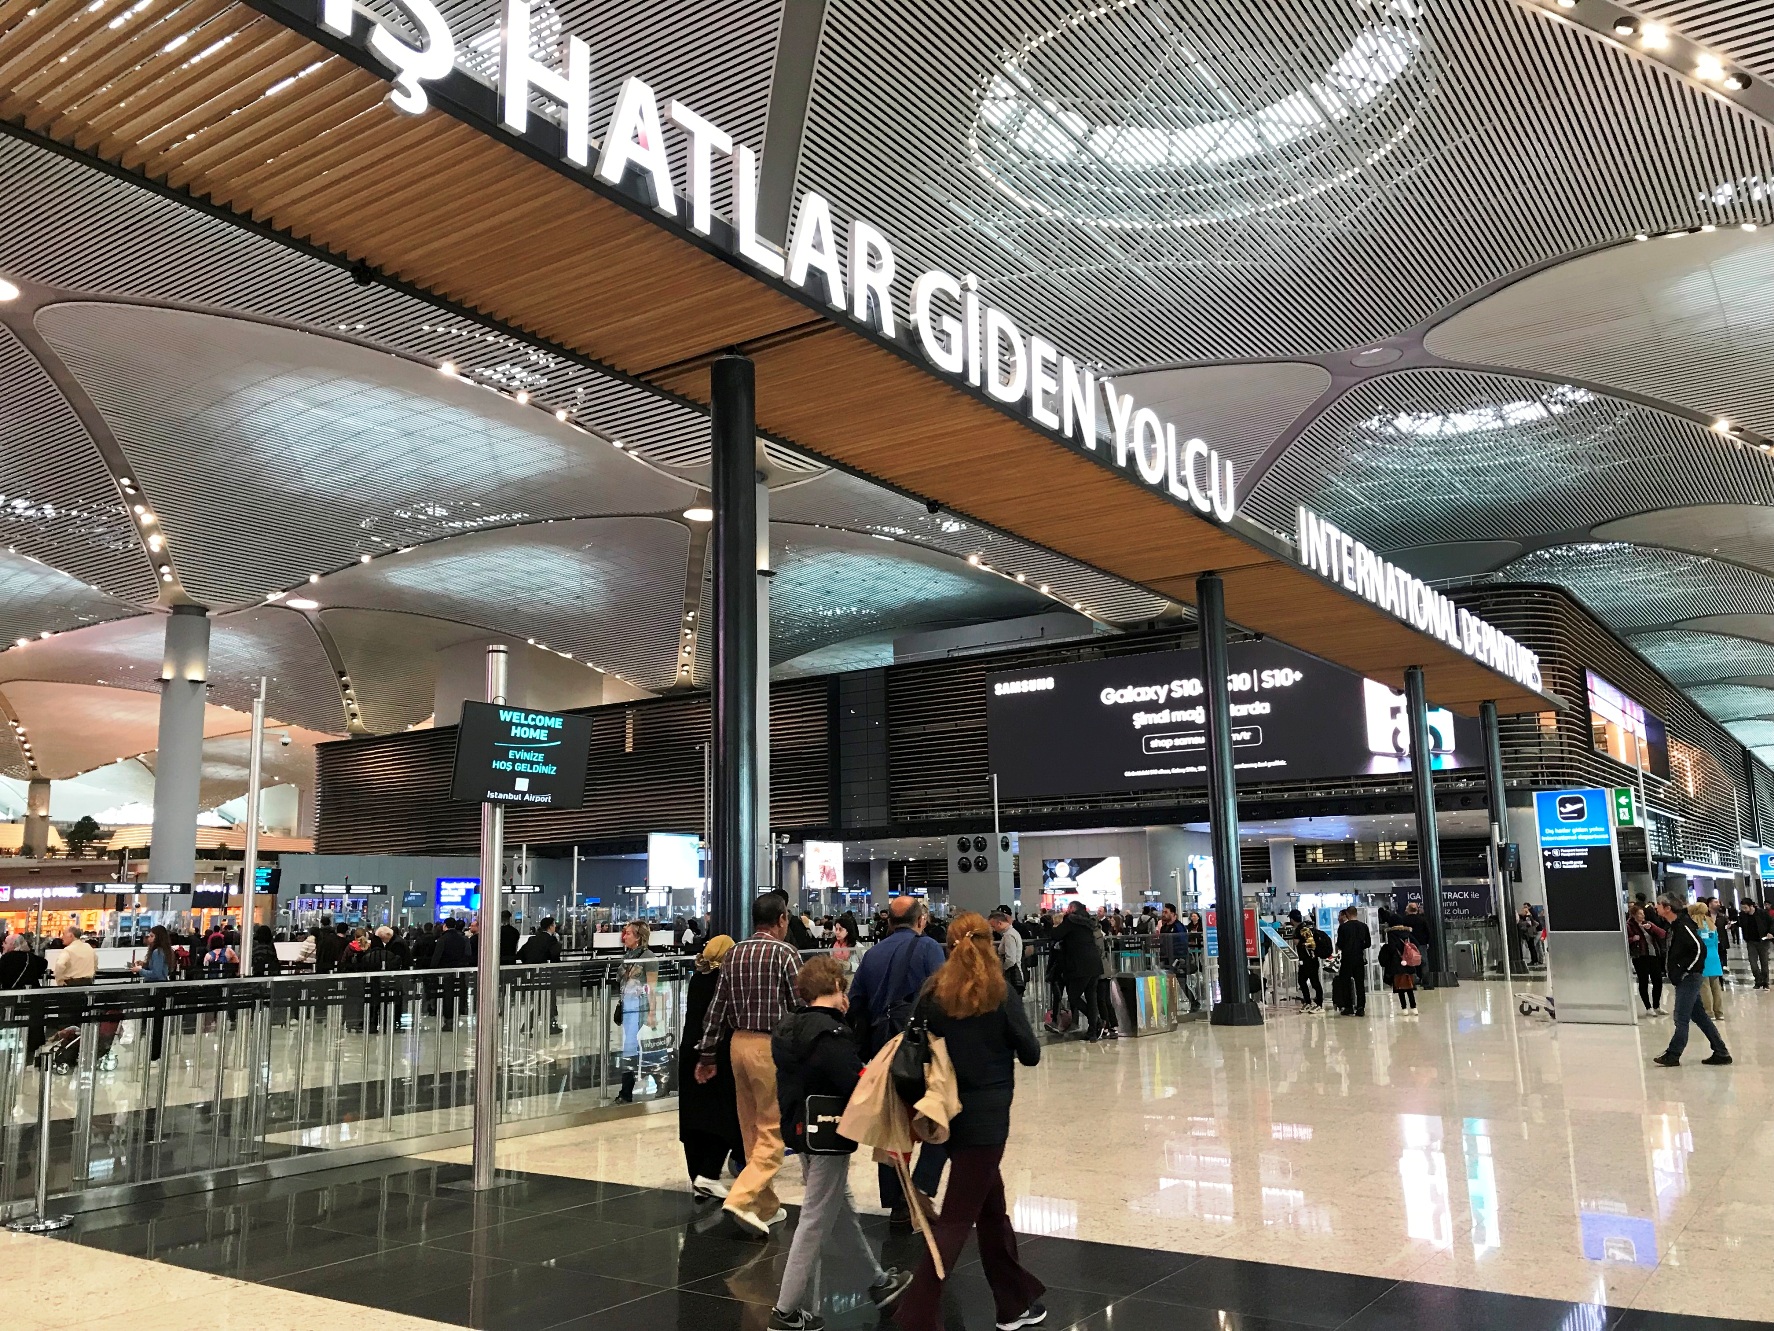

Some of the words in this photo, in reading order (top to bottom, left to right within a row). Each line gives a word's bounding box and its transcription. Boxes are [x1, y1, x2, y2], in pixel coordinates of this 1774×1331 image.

[501, 0, 896, 338] HATLAR
[910, 270, 1096, 451] GİDEN
[1100, 381, 1235, 523] YOLCU
[1299, 505, 1462, 650] INTERNATIONAL
[1458, 607, 1543, 693] DEPARTURES
[994, 677, 1055, 696] SAMSUNG
[1100, 684, 1169, 705] Galaxy
[1170, 678, 1204, 698] S10
[1261, 668, 1304, 689] S10+
[499, 709, 564, 729] WELCOME
[1132, 709, 1171, 729] Şimdi
[510, 725, 549, 741] HOME
[508, 749, 545, 762] EVİNİZE
[492, 760, 513, 772] HOŞ
[514, 763, 557, 775] GELDİNİZ
[487, 790, 522, 801] Istanbul
[523, 793, 552, 803] Airport
[1442, 891, 1469, 899] TRACK
[1470, 891, 1480, 899] ile
[1452, 907, 1470, 915] olun
